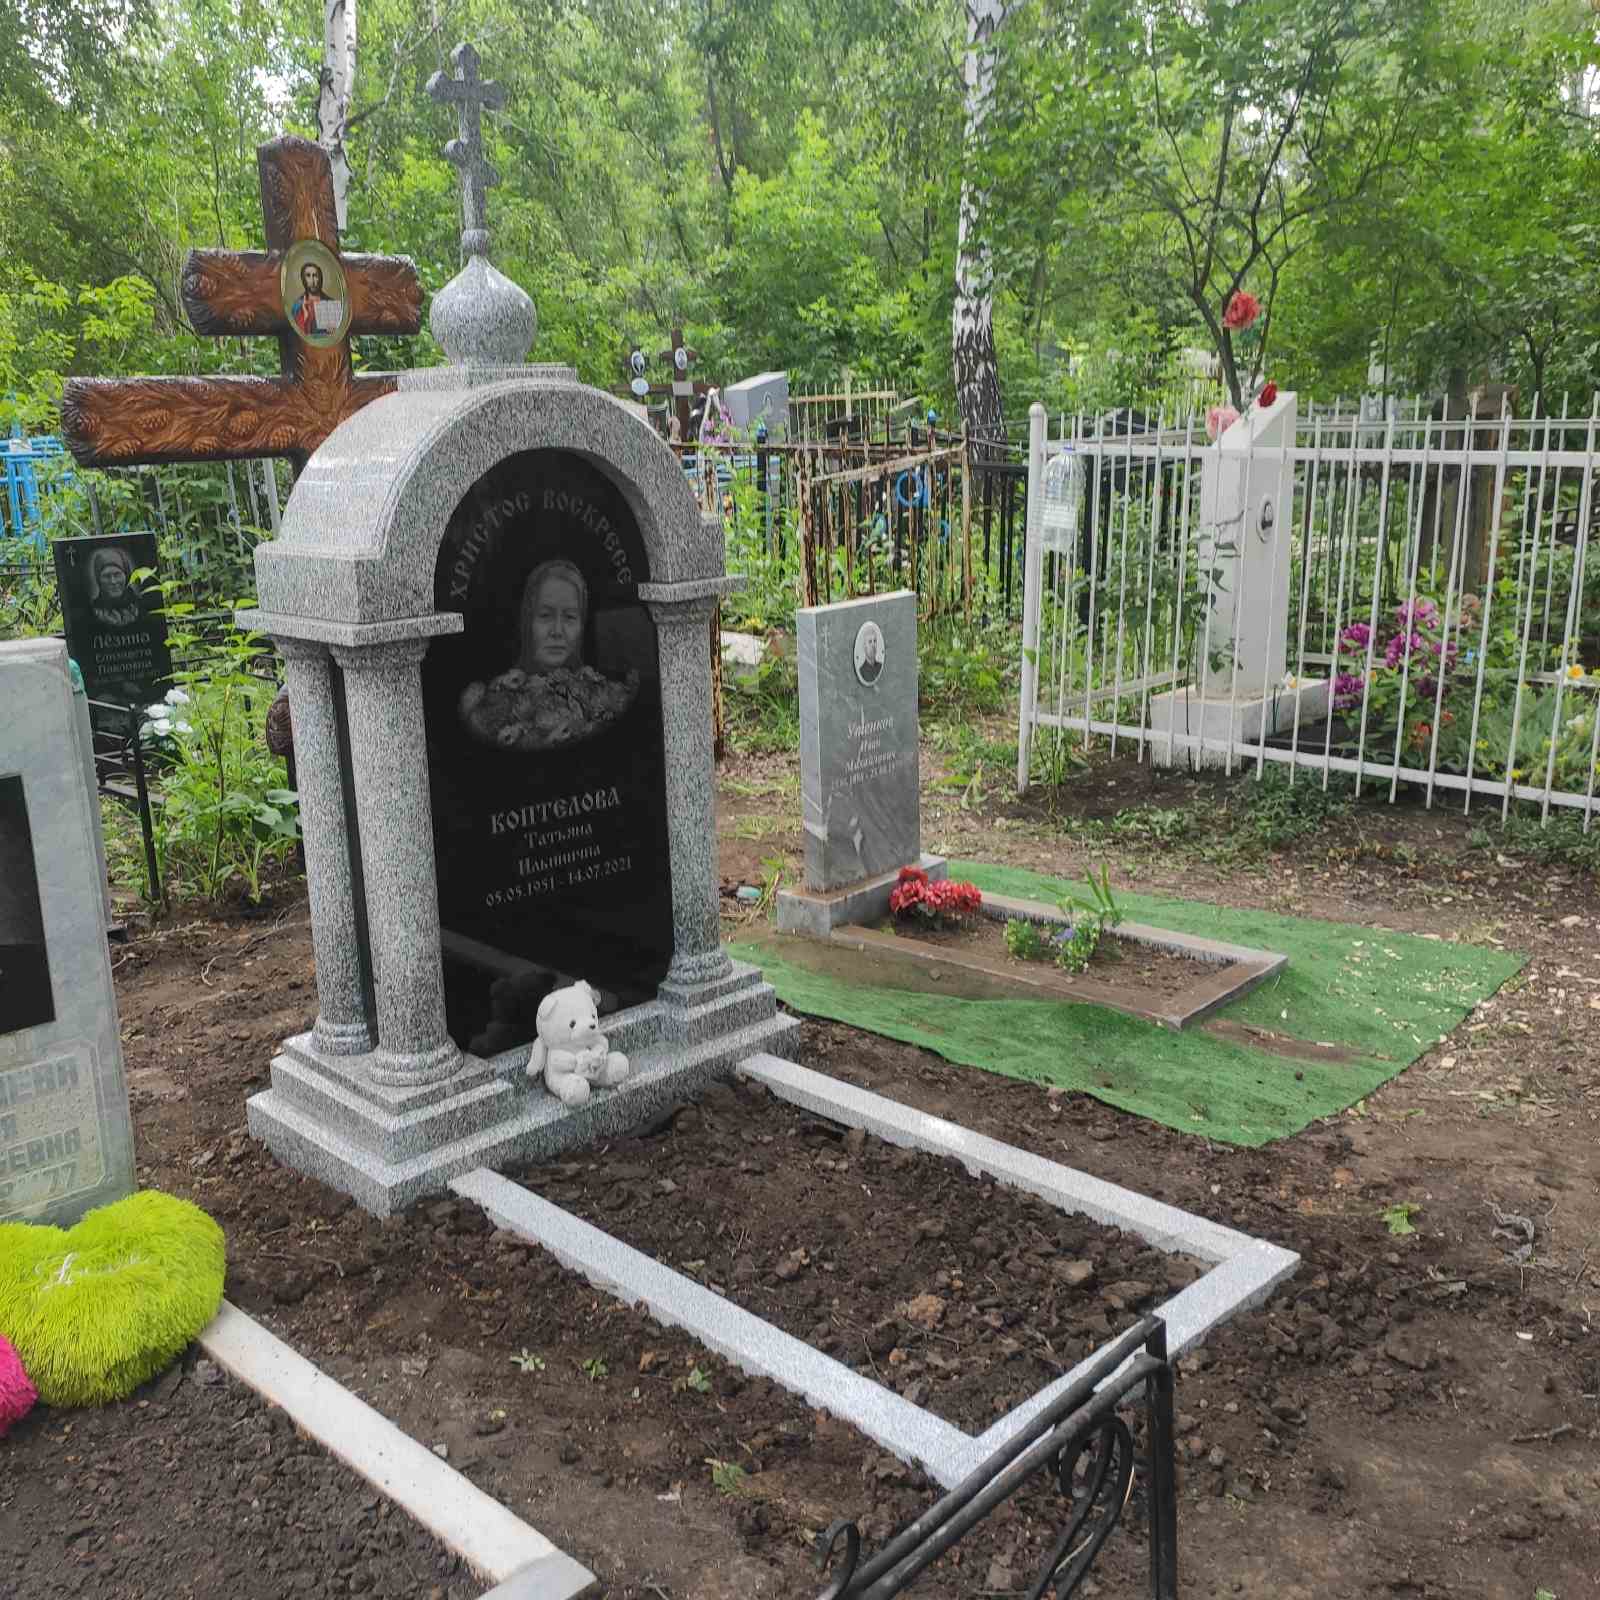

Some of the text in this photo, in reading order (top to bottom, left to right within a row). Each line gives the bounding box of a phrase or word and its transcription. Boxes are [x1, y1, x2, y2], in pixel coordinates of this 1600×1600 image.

[450, 490, 530, 601] ХРИСТОС
[491, 786, 622, 835] КОПТЕЛОВА
[517, 844, 601, 877] Ильинична
[523, 823, 593, 849] Татьяна
[485, 875, 556, 908] 05.05.1951
[567, 855, 632, 886] 14.07.2021
